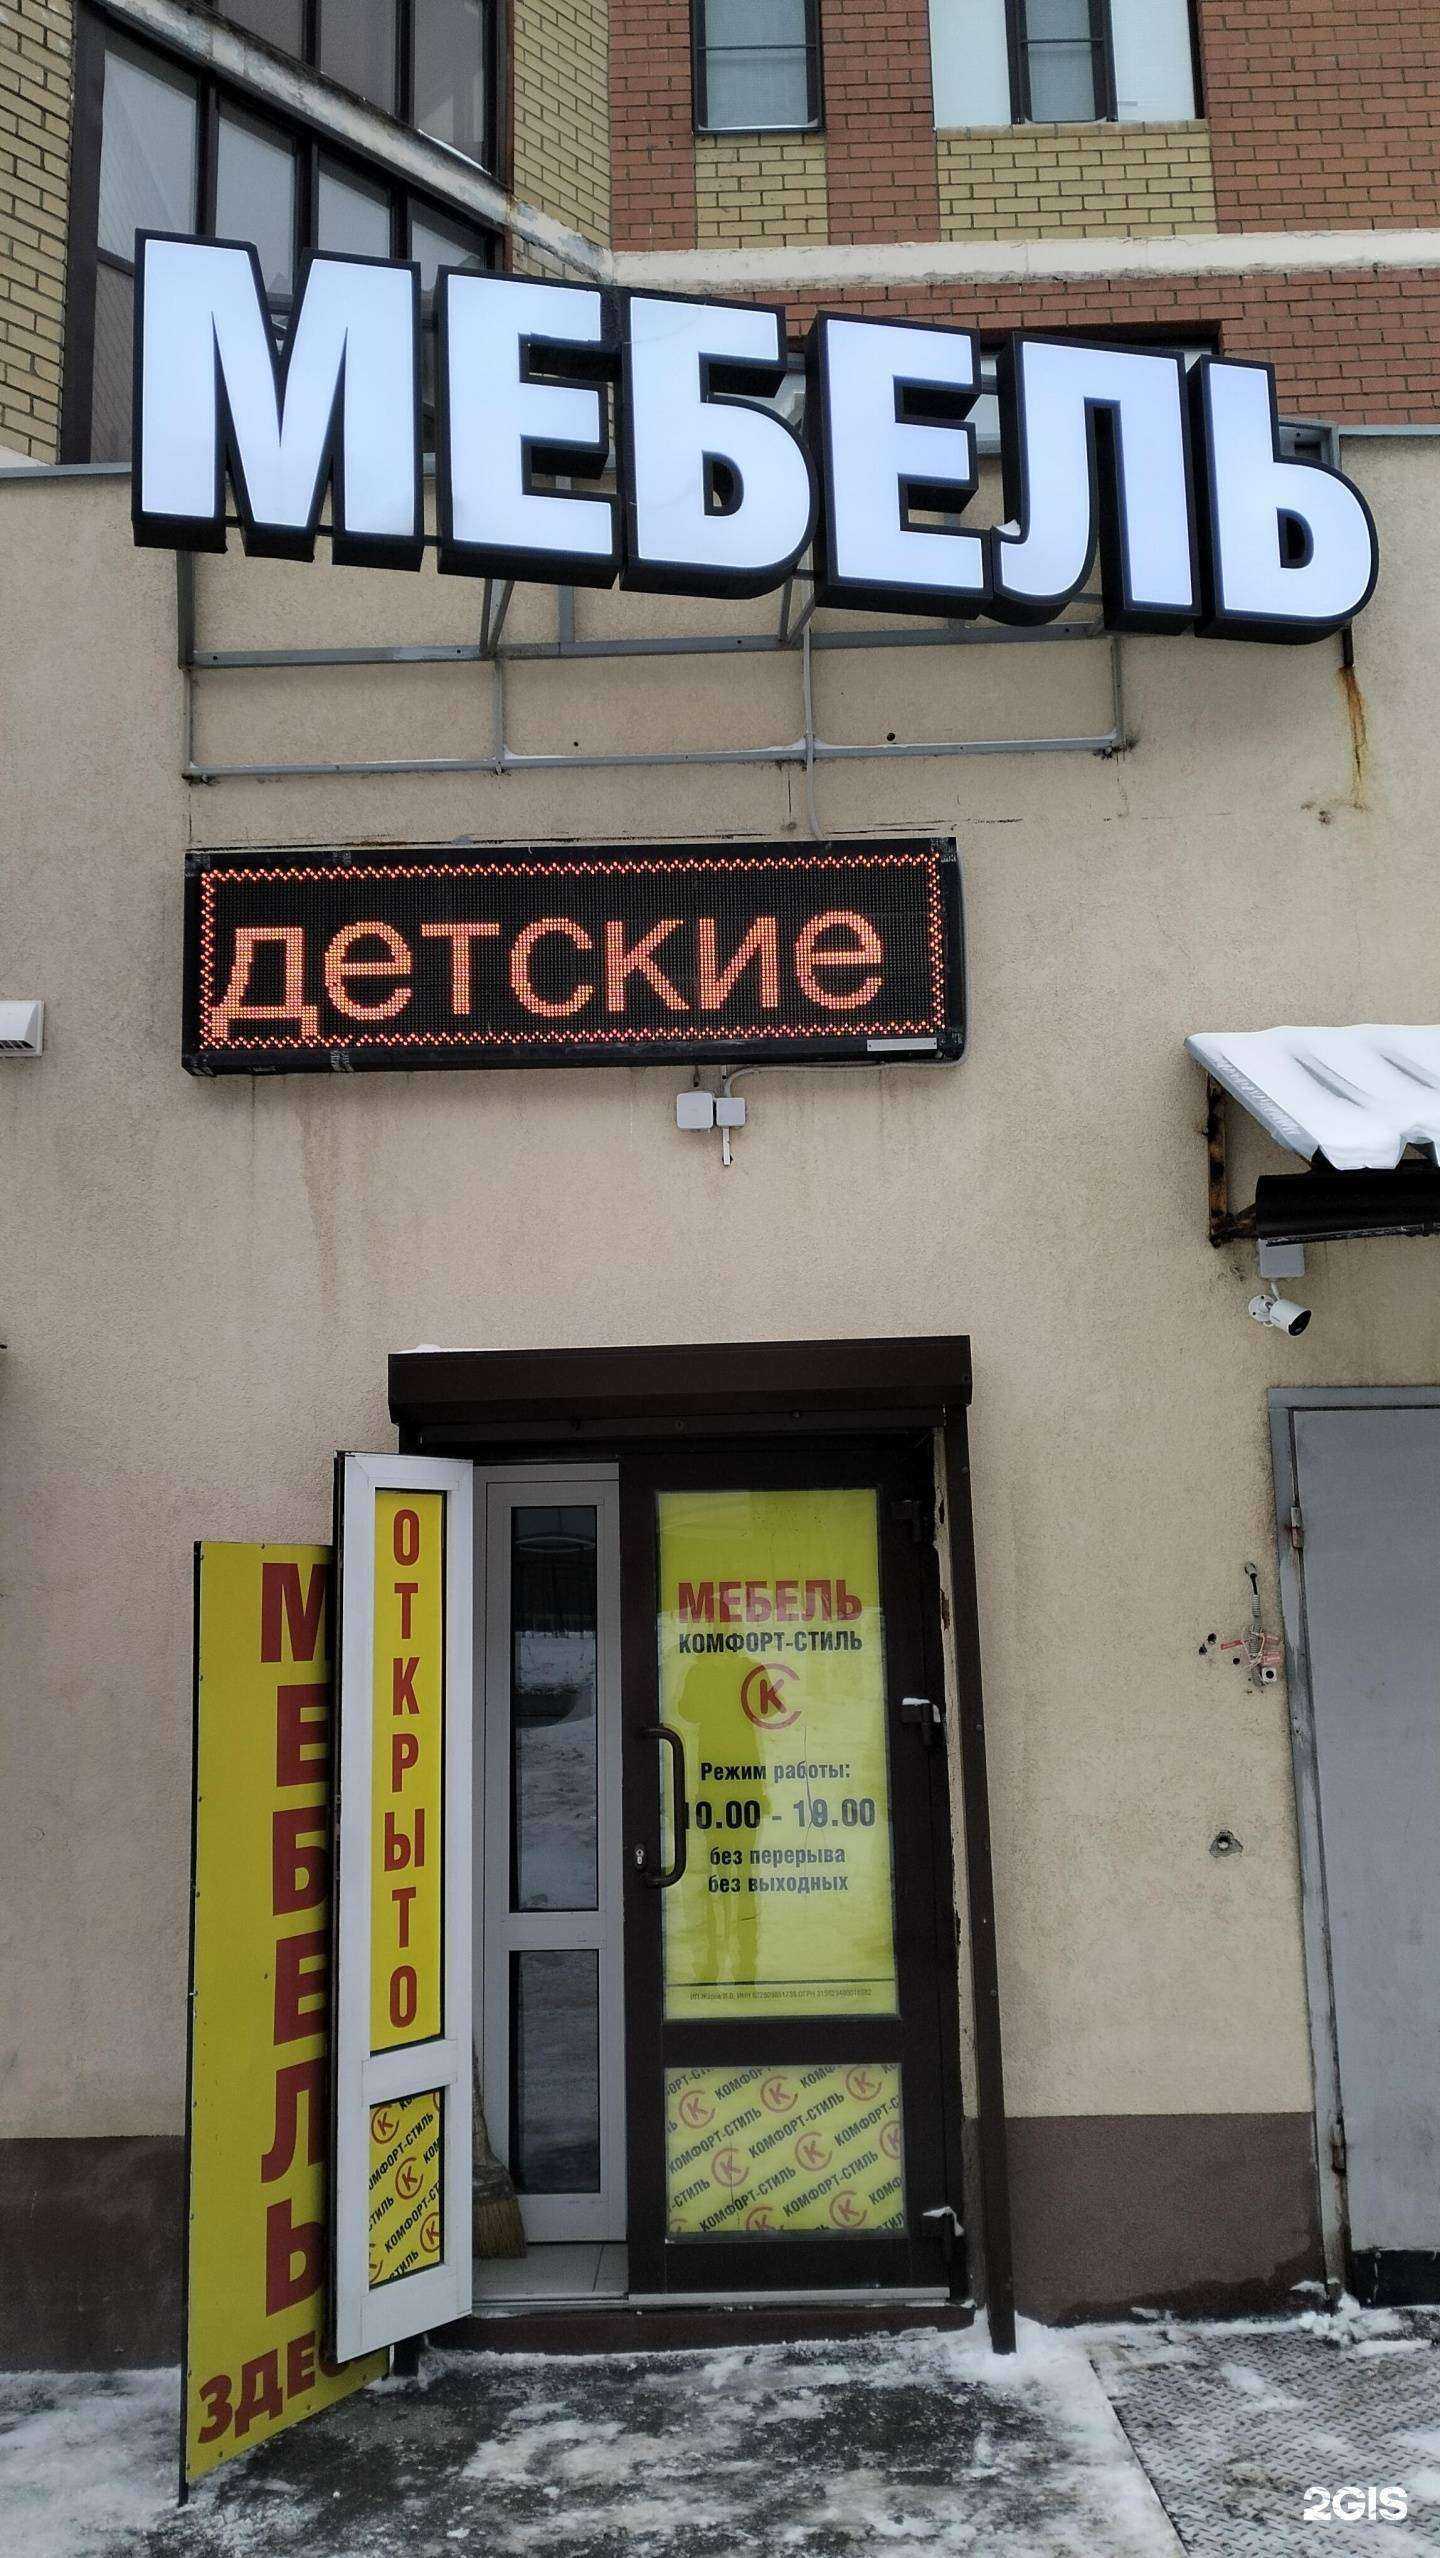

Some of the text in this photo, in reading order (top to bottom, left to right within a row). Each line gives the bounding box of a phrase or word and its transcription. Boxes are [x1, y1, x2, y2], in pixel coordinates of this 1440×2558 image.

[138, 233, 1376, 626] МЕБЕЛЬ
[210, 909, 883, 1037] детские
[677, 1579, 863, 1624] МЕБЕЛЬ
[678, 1630, 863, 1654] КОМФОРТ-СТИЛЬ
[384, 1509, 425, 2029] ОТКРЫТО
[701, 1760, 851, 1783] Режим работы:
[708, 1875, 849, 1894] без выходных
[710, 1847, 846, 1869] без перерыва
[748, 2092, 845, 2159] КОМФОРТ-СТИЛЬ
[699, 2166, 797, 2233] КОМФОРТ-СТИЛЬ
[782, 2150, 879, 2218] КОМФОРТ-СТИЛЬ
